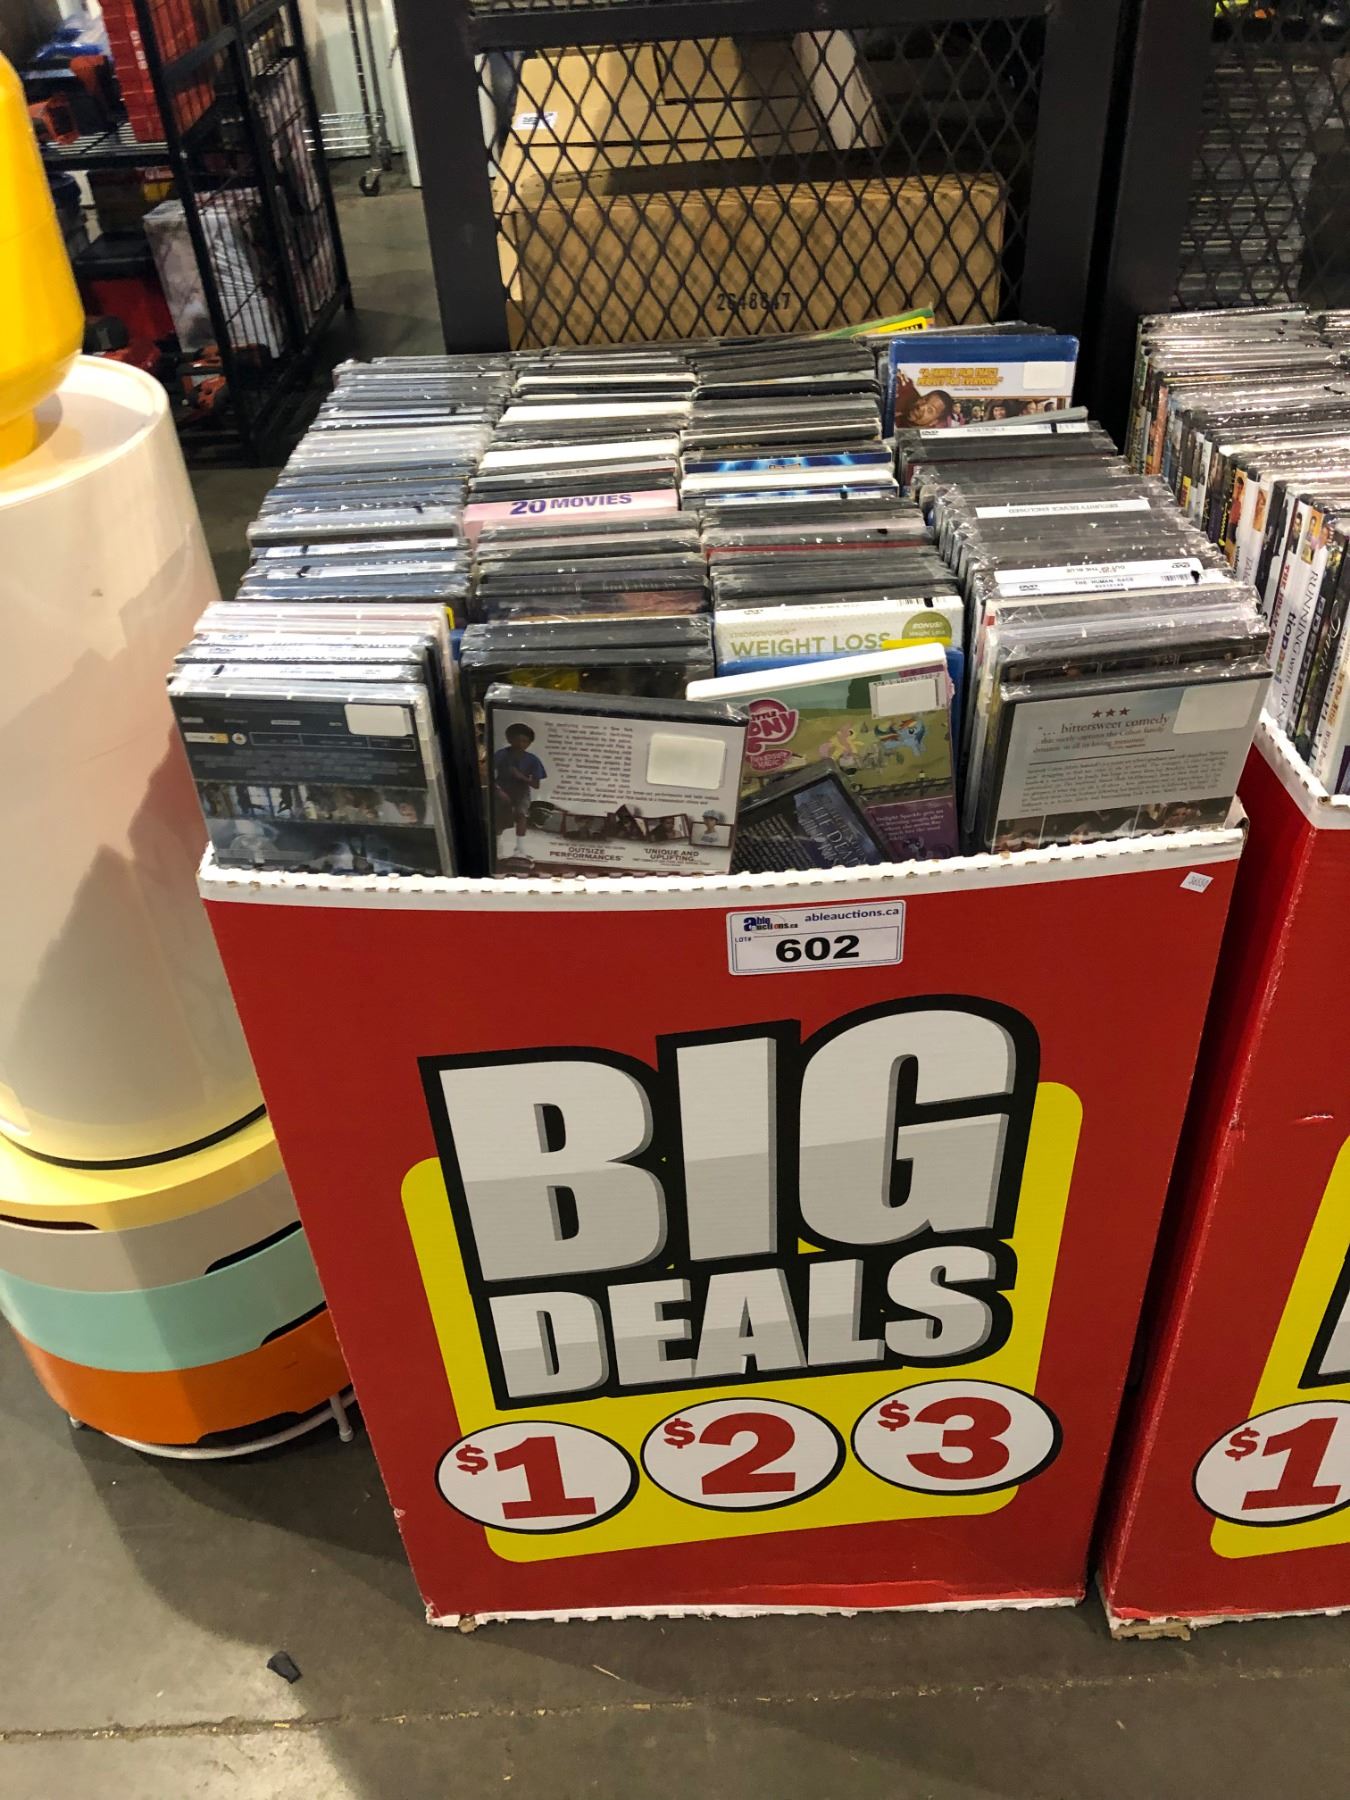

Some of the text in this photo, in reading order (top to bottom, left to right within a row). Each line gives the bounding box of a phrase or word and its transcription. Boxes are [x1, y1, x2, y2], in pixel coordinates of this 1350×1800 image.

[510, 494, 632, 515] 20 MOVIES
[1008, 502, 1119, 514] SECURITY DEVICE ENCLOSED
[1281, 564, 1291, 590] THE
[1272, 592, 1285, 628] JOLLY
[1294, 570, 1319, 653] RUNNING
[731, 632, 891, 657] WEIGHT LOSS
[751, 711, 777, 721] ITTLE
[1275, 688, 1290, 723] ARN
[747, 711, 797, 741] ONY
[1061, 721, 1122, 734] bittersweet
[1125, 713, 1168, 728] comedy
[568, 846, 606, 855] OUTSIZE
[804, 908, 899, 922] ableauctions.ca
[776, 935, 860, 963] 602
[438, 1009, 1017, 1281] BIG
[488, 1244, 997, 1399] DEALS
[664, 1412, 796, 1495] $2
[877, 1397, 1013, 1480] $3
[455, 1436, 597, 1520] $1
[1224, 1417, 1341, 1511] $1
